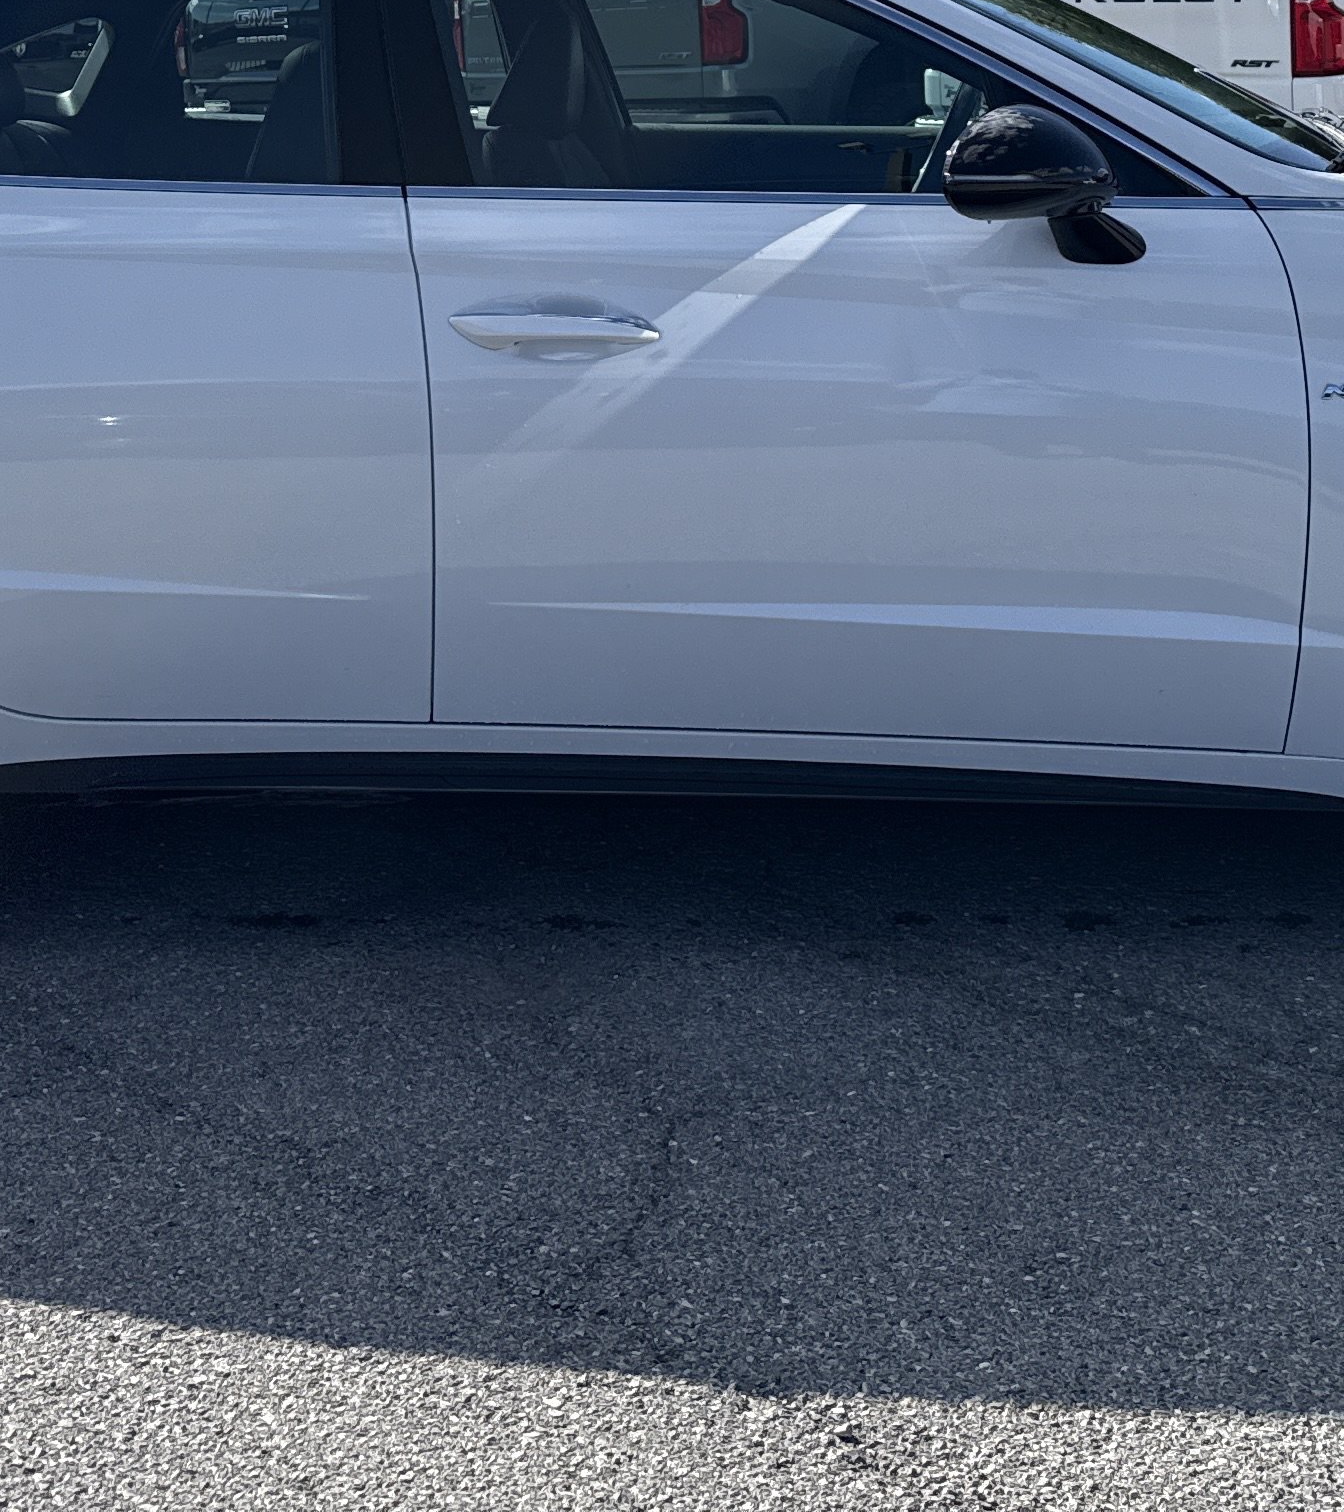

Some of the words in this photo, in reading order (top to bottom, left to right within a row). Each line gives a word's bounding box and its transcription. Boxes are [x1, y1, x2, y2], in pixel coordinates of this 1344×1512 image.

[233, 6, 289, 28] GMC
[236, 34, 288, 44] SIERRA
[1230, 59, 1281, 68] RST
